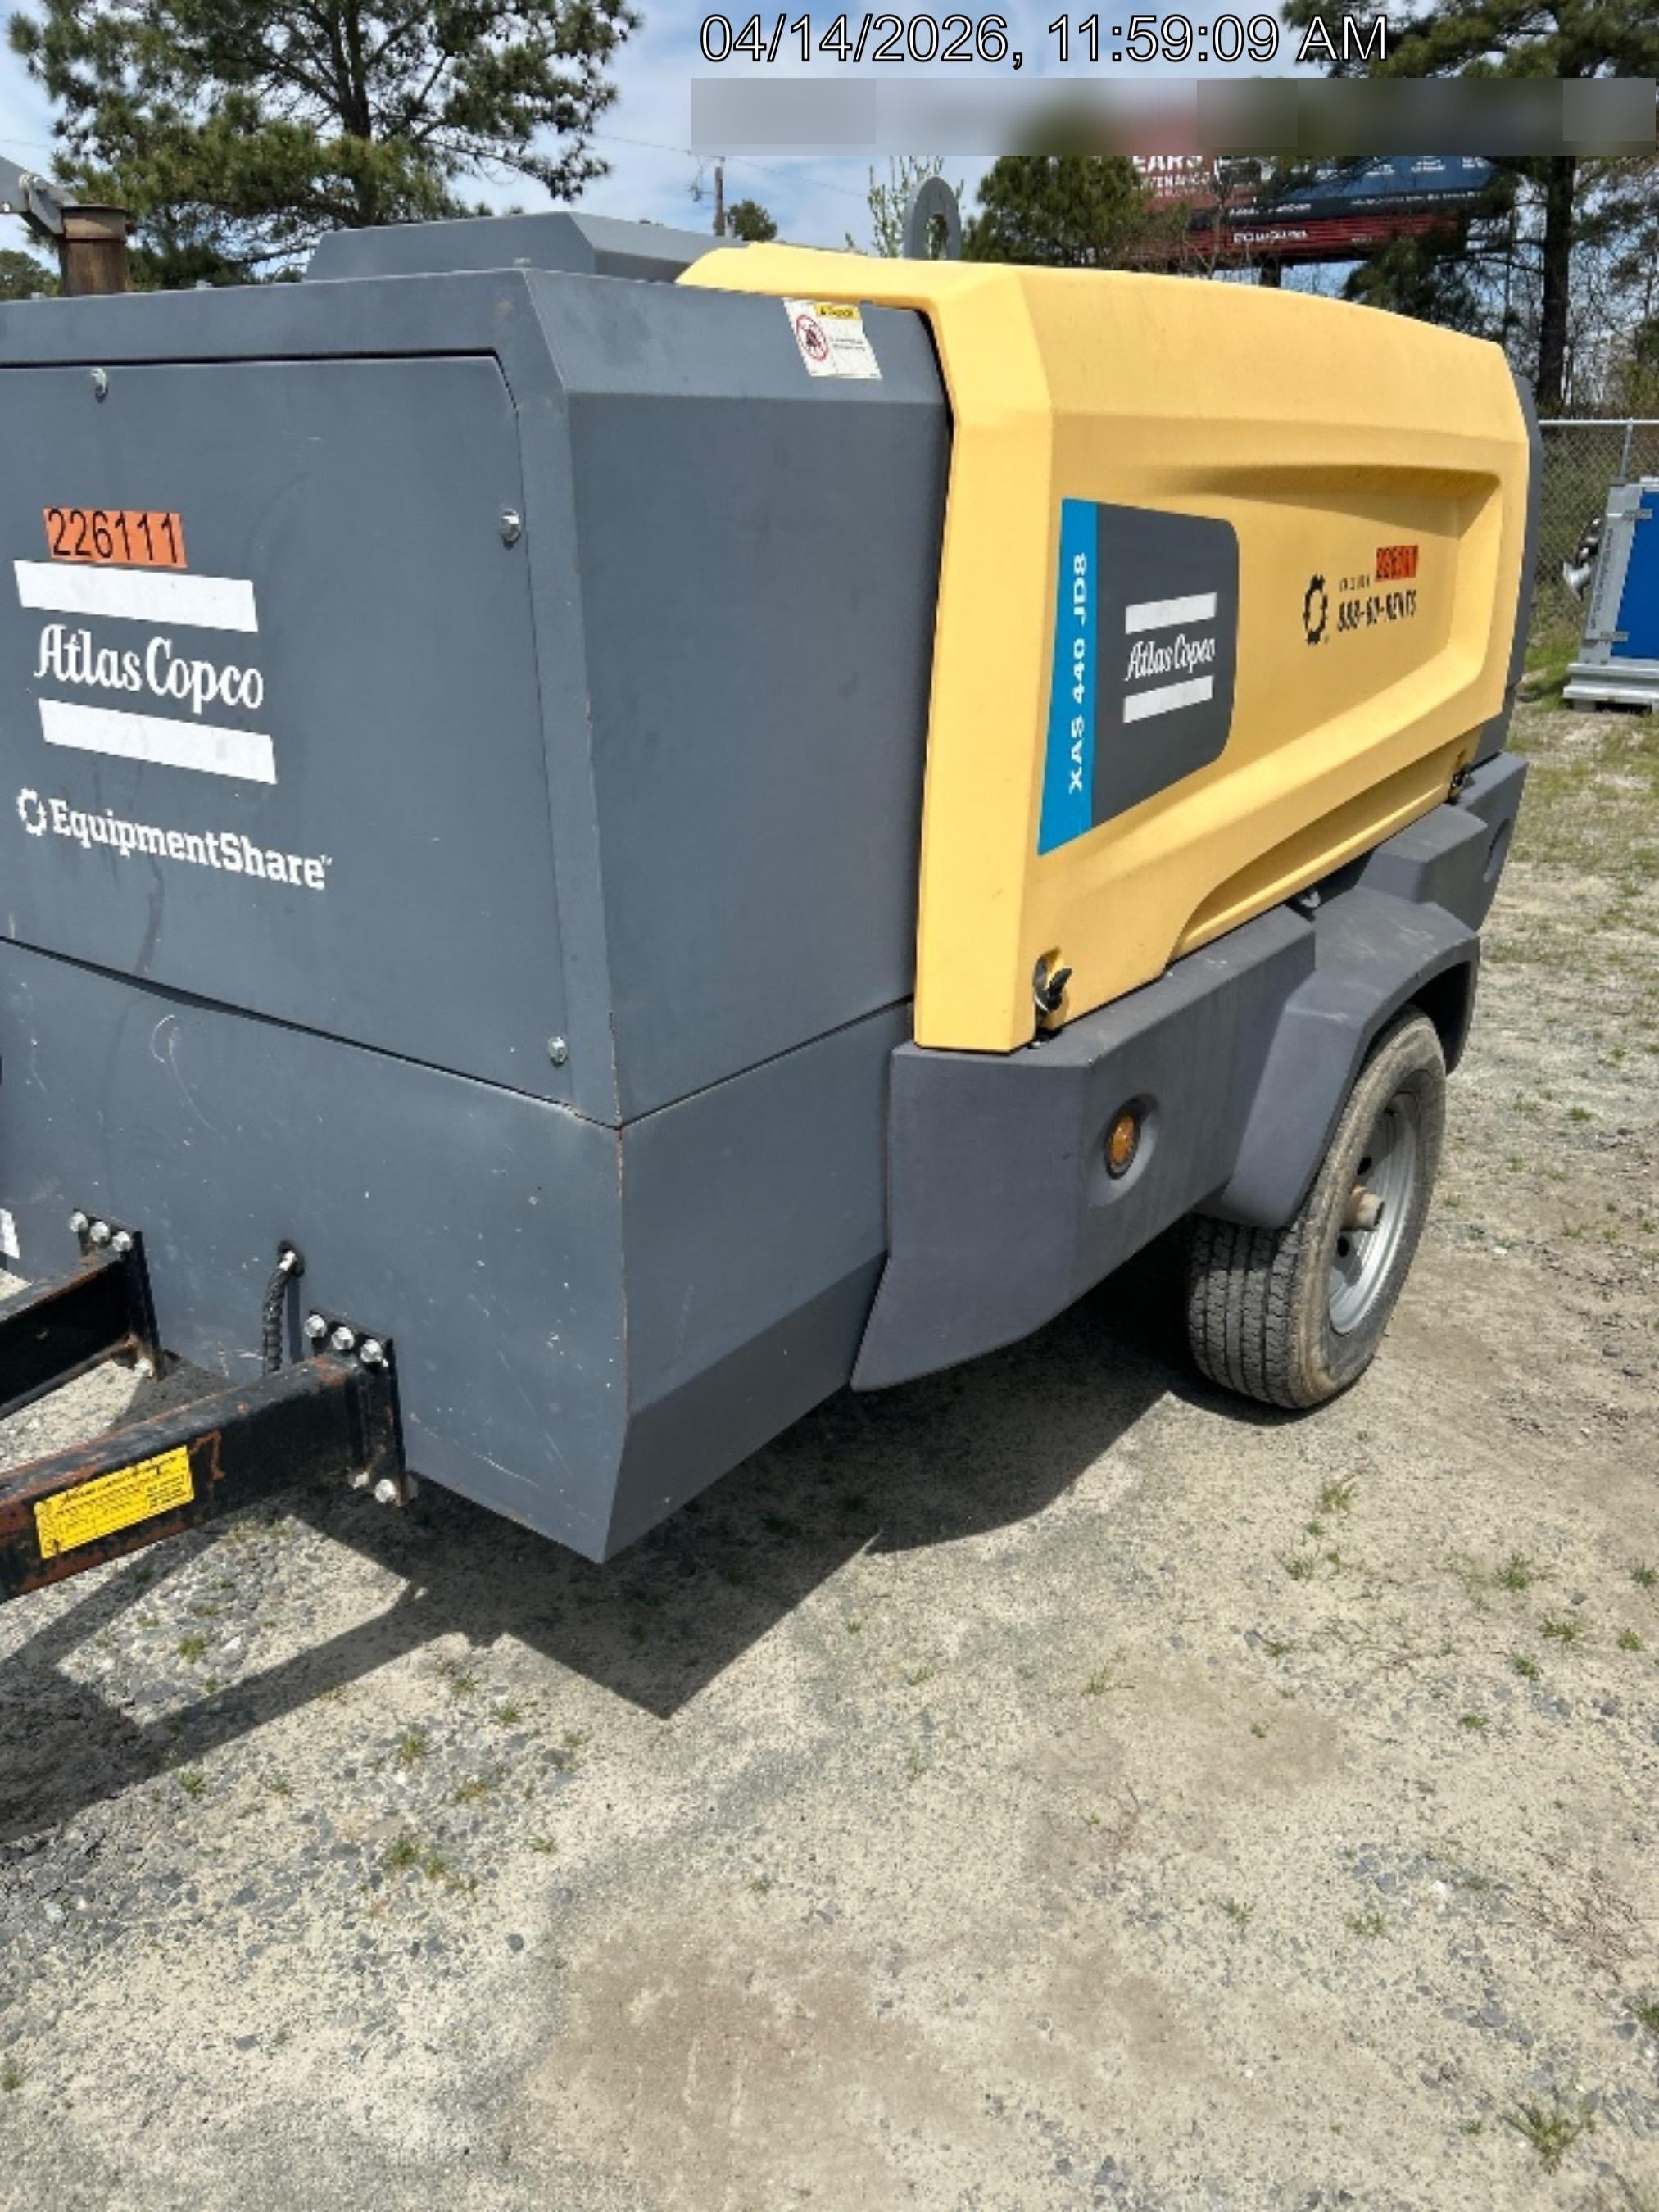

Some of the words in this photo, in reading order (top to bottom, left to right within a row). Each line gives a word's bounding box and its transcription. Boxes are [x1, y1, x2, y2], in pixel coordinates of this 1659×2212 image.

[48, 508, 179, 564] 226111
[1072, 552, 1087, 625] JD8
[34, 623, 143, 692] Atlas
[146, 636, 264, 714] Copco
[1072, 639, 1086, 704] 440
[1123, 640, 1173, 682] Atlas
[1173, 633, 1216, 674] Copco
[1069, 714, 1086, 793] XAS
[48, 797, 330, 890] EquipmentShare
